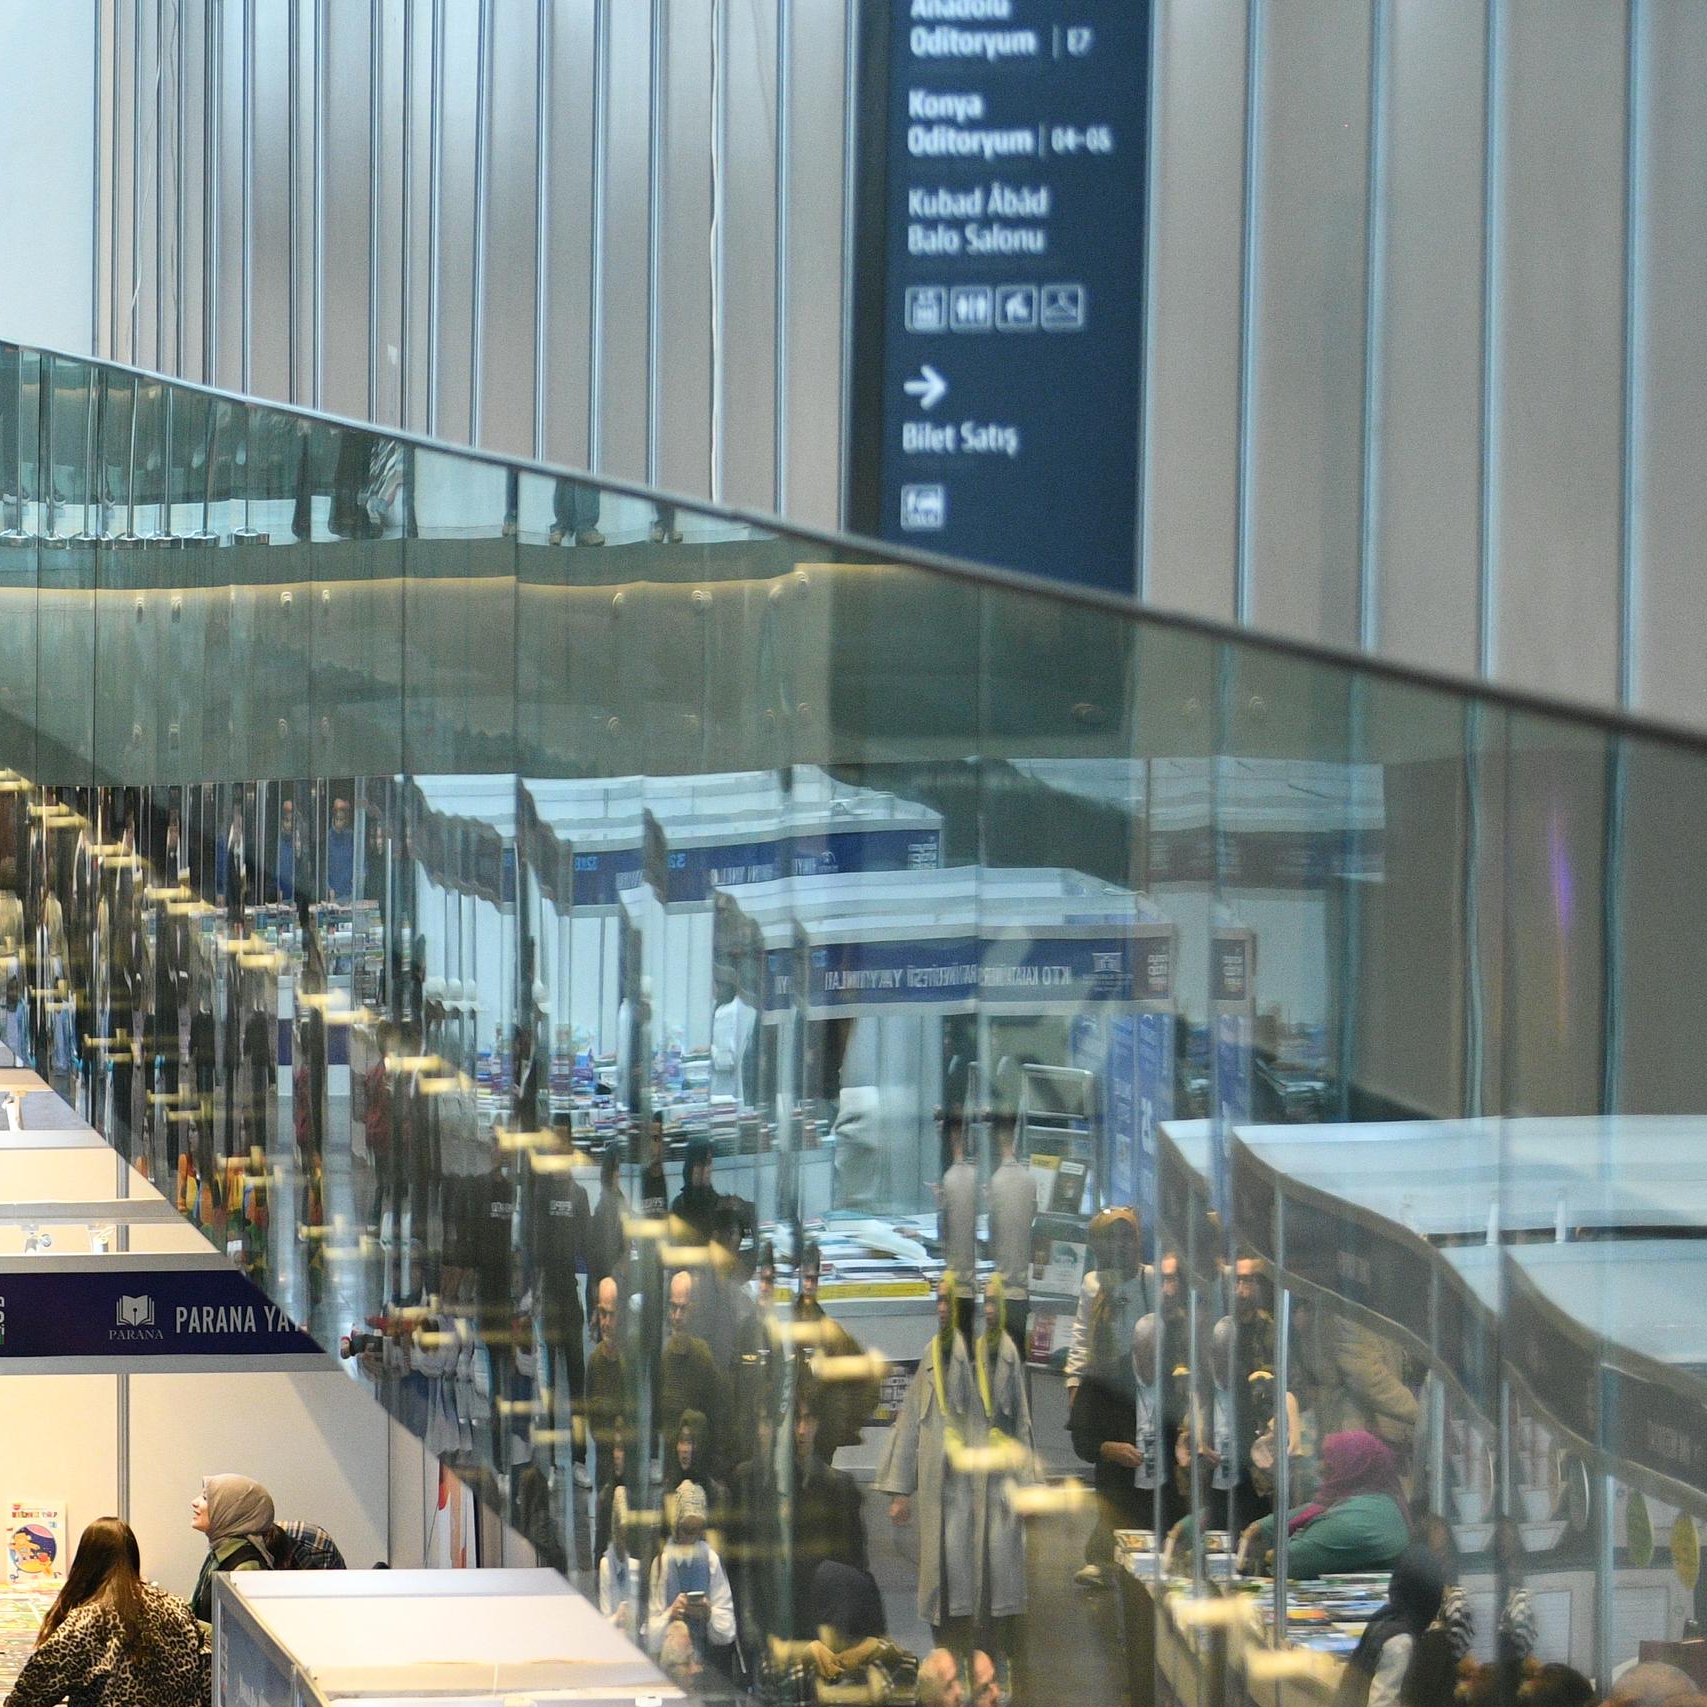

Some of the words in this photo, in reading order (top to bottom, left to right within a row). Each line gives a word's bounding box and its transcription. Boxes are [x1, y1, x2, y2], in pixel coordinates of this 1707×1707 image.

[910, 28, 1036, 62] Oditoryum
[908, 90, 982, 123] Konya
[907, 126, 1033, 160] Oditoryum
[908, 188, 982, 218] Kubad
[907, 225, 959, 255] Balo
[965, 225, 1044, 255] Salonu
[902, 422, 955, 454] Bilet
[961, 422, 1017, 456] Satış
[109, 1329, 164, 1341] PARANA
[176, 1305, 256, 1334] PARANA
